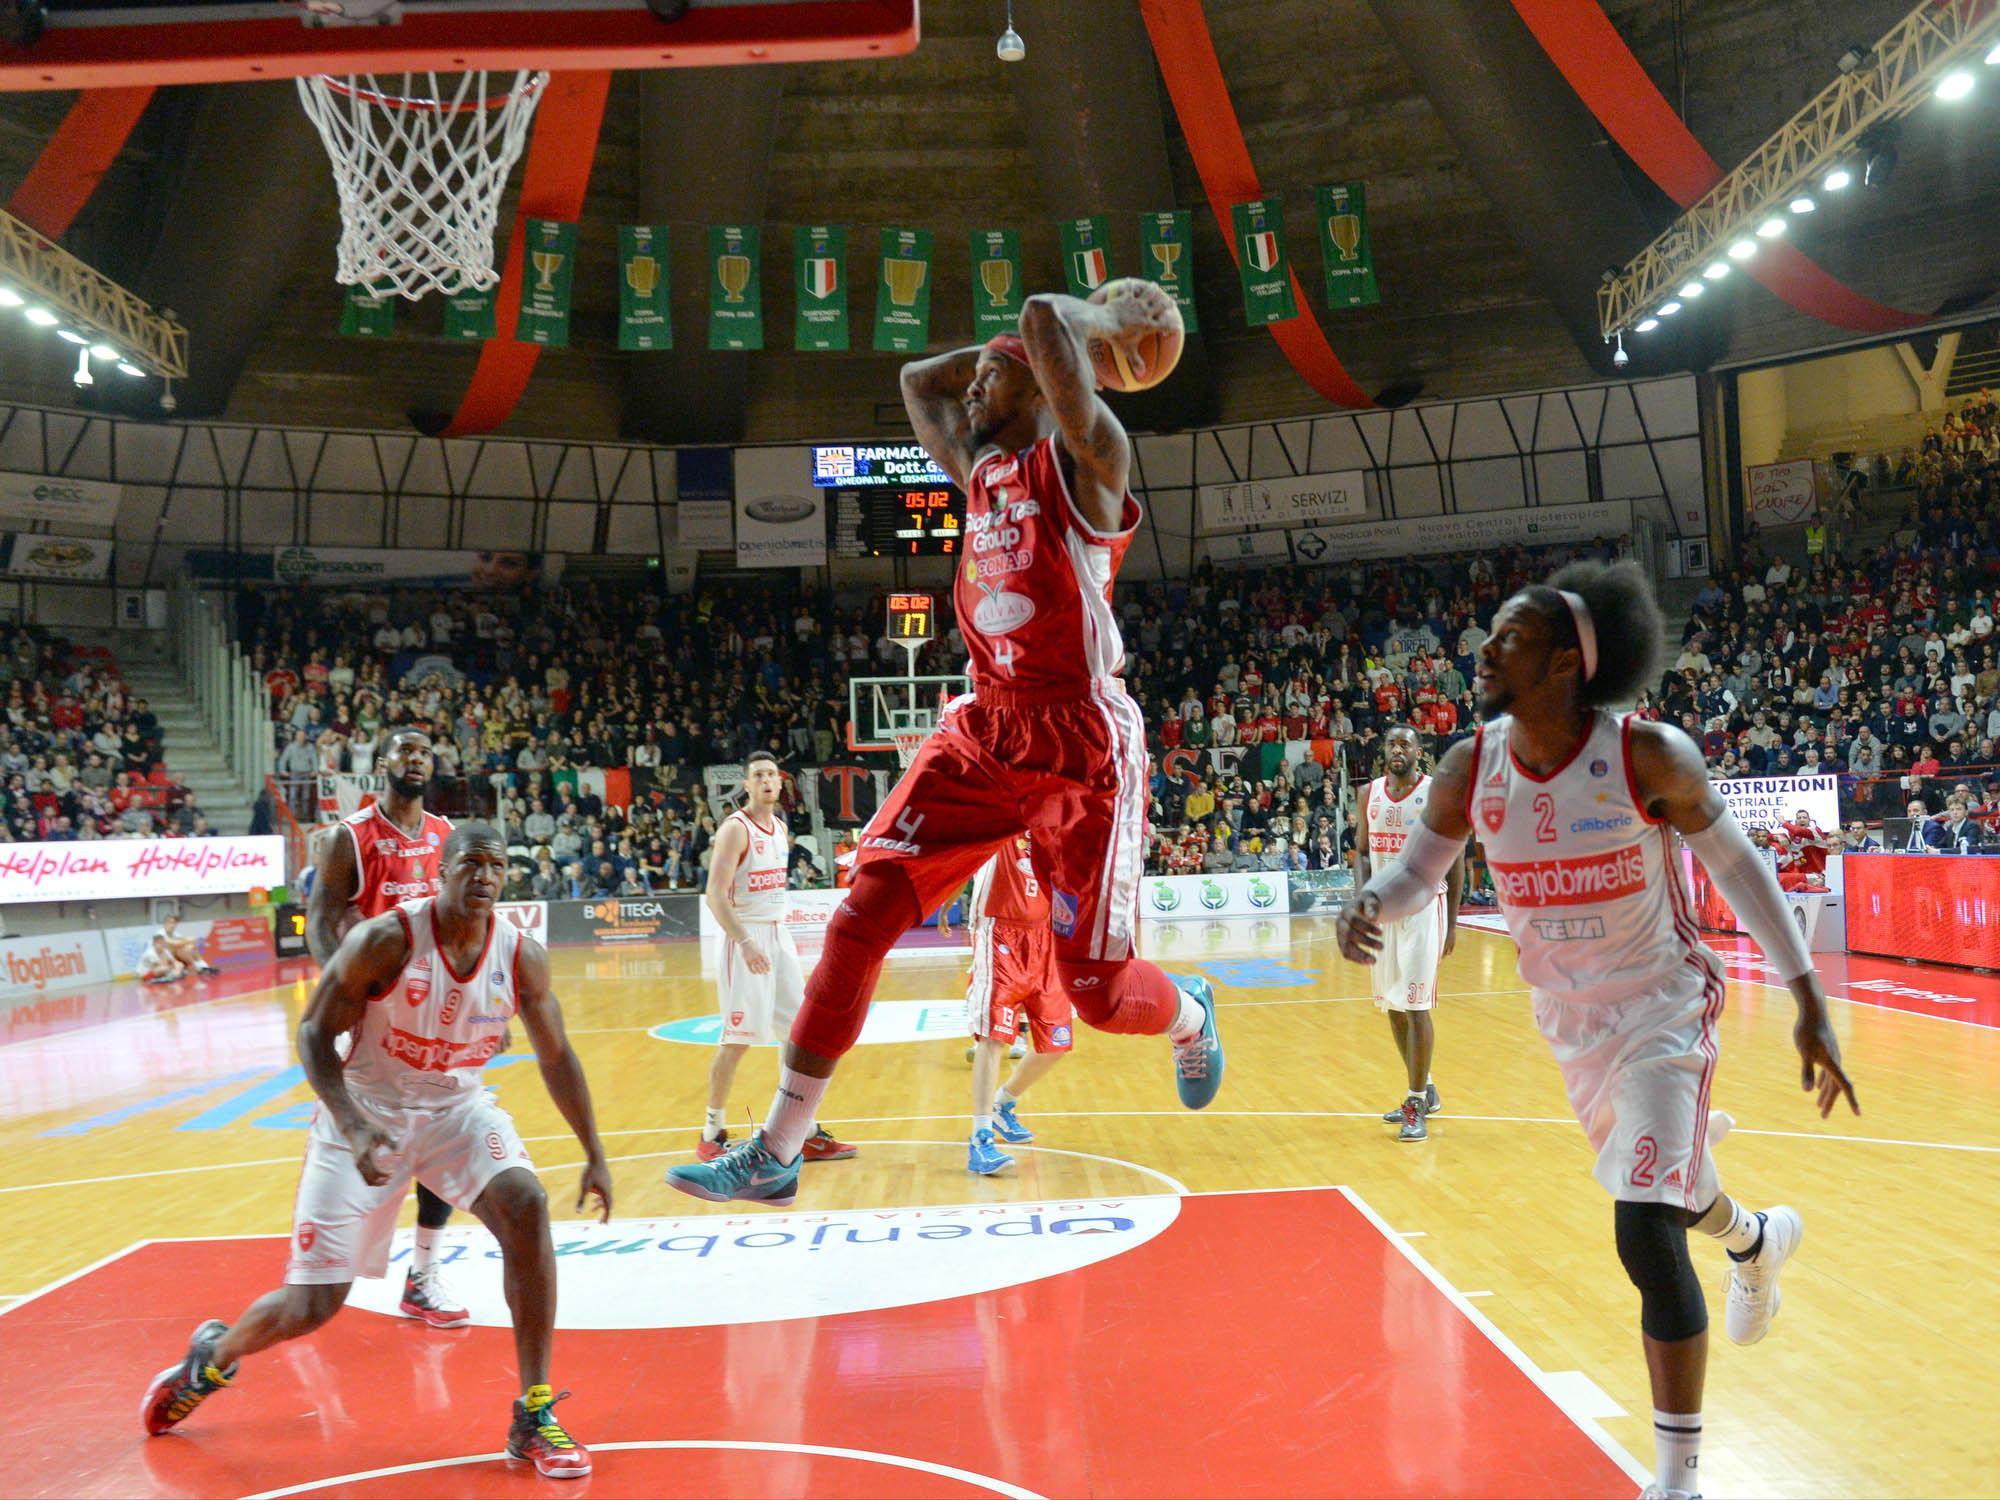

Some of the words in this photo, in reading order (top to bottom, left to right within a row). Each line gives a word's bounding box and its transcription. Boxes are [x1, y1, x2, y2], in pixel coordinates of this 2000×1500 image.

[1290, 489, 1348, 508] SERVIZI
[903, 613, 926, 636] 17
[1727, 796, 1788, 808] STRIALE,
[895, 805, 925, 842] 4
[1532, 792, 1558, 844] 2
[1731, 809, 1768, 820] AURO
[862, 836, 921, 856] LEGEA
[0, 849, 111, 886] telplan
[127, 844, 269, 879] Hotelplan
[1500, 854, 1647, 907] penjobmetis
[784, 909, 828, 923] ellicce
[1630, 1135, 1658, 1188] 2
[873, 1201, 1127, 1220] AGENZIA
